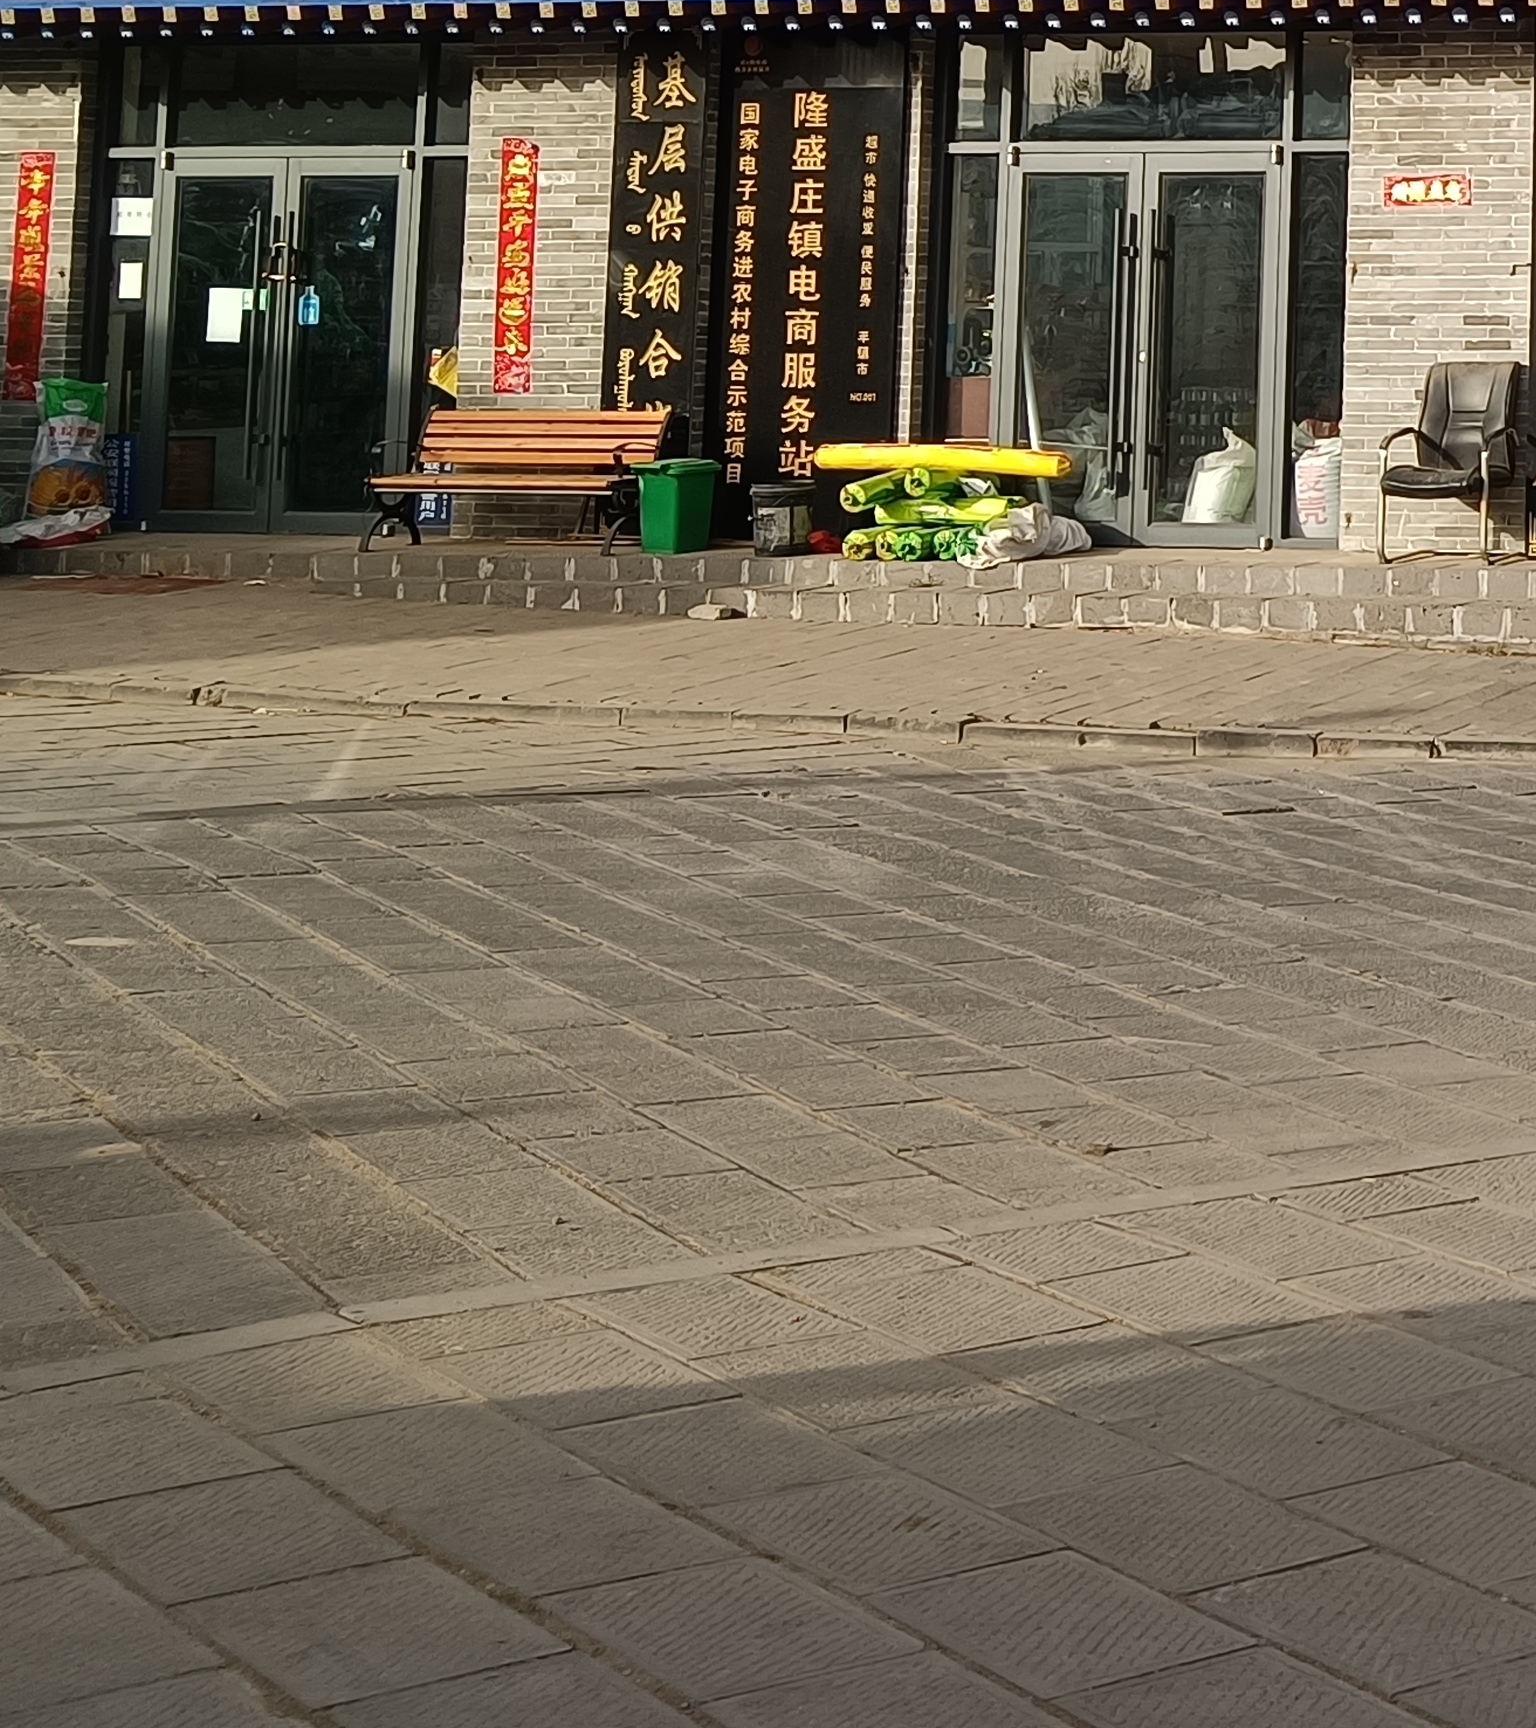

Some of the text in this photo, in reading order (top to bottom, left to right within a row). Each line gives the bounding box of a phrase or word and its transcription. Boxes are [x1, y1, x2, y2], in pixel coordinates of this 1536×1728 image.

[638, 51, 697, 412] 基层供销合
[724, 102, 761, 485] 国家电子商务进农村综合示范项目
[778, 91, 830, 478] 隆盛庄镇电商服务站
[859, 245, 875, 308] 便民服务
[864, 135, 879, 165] 超市
